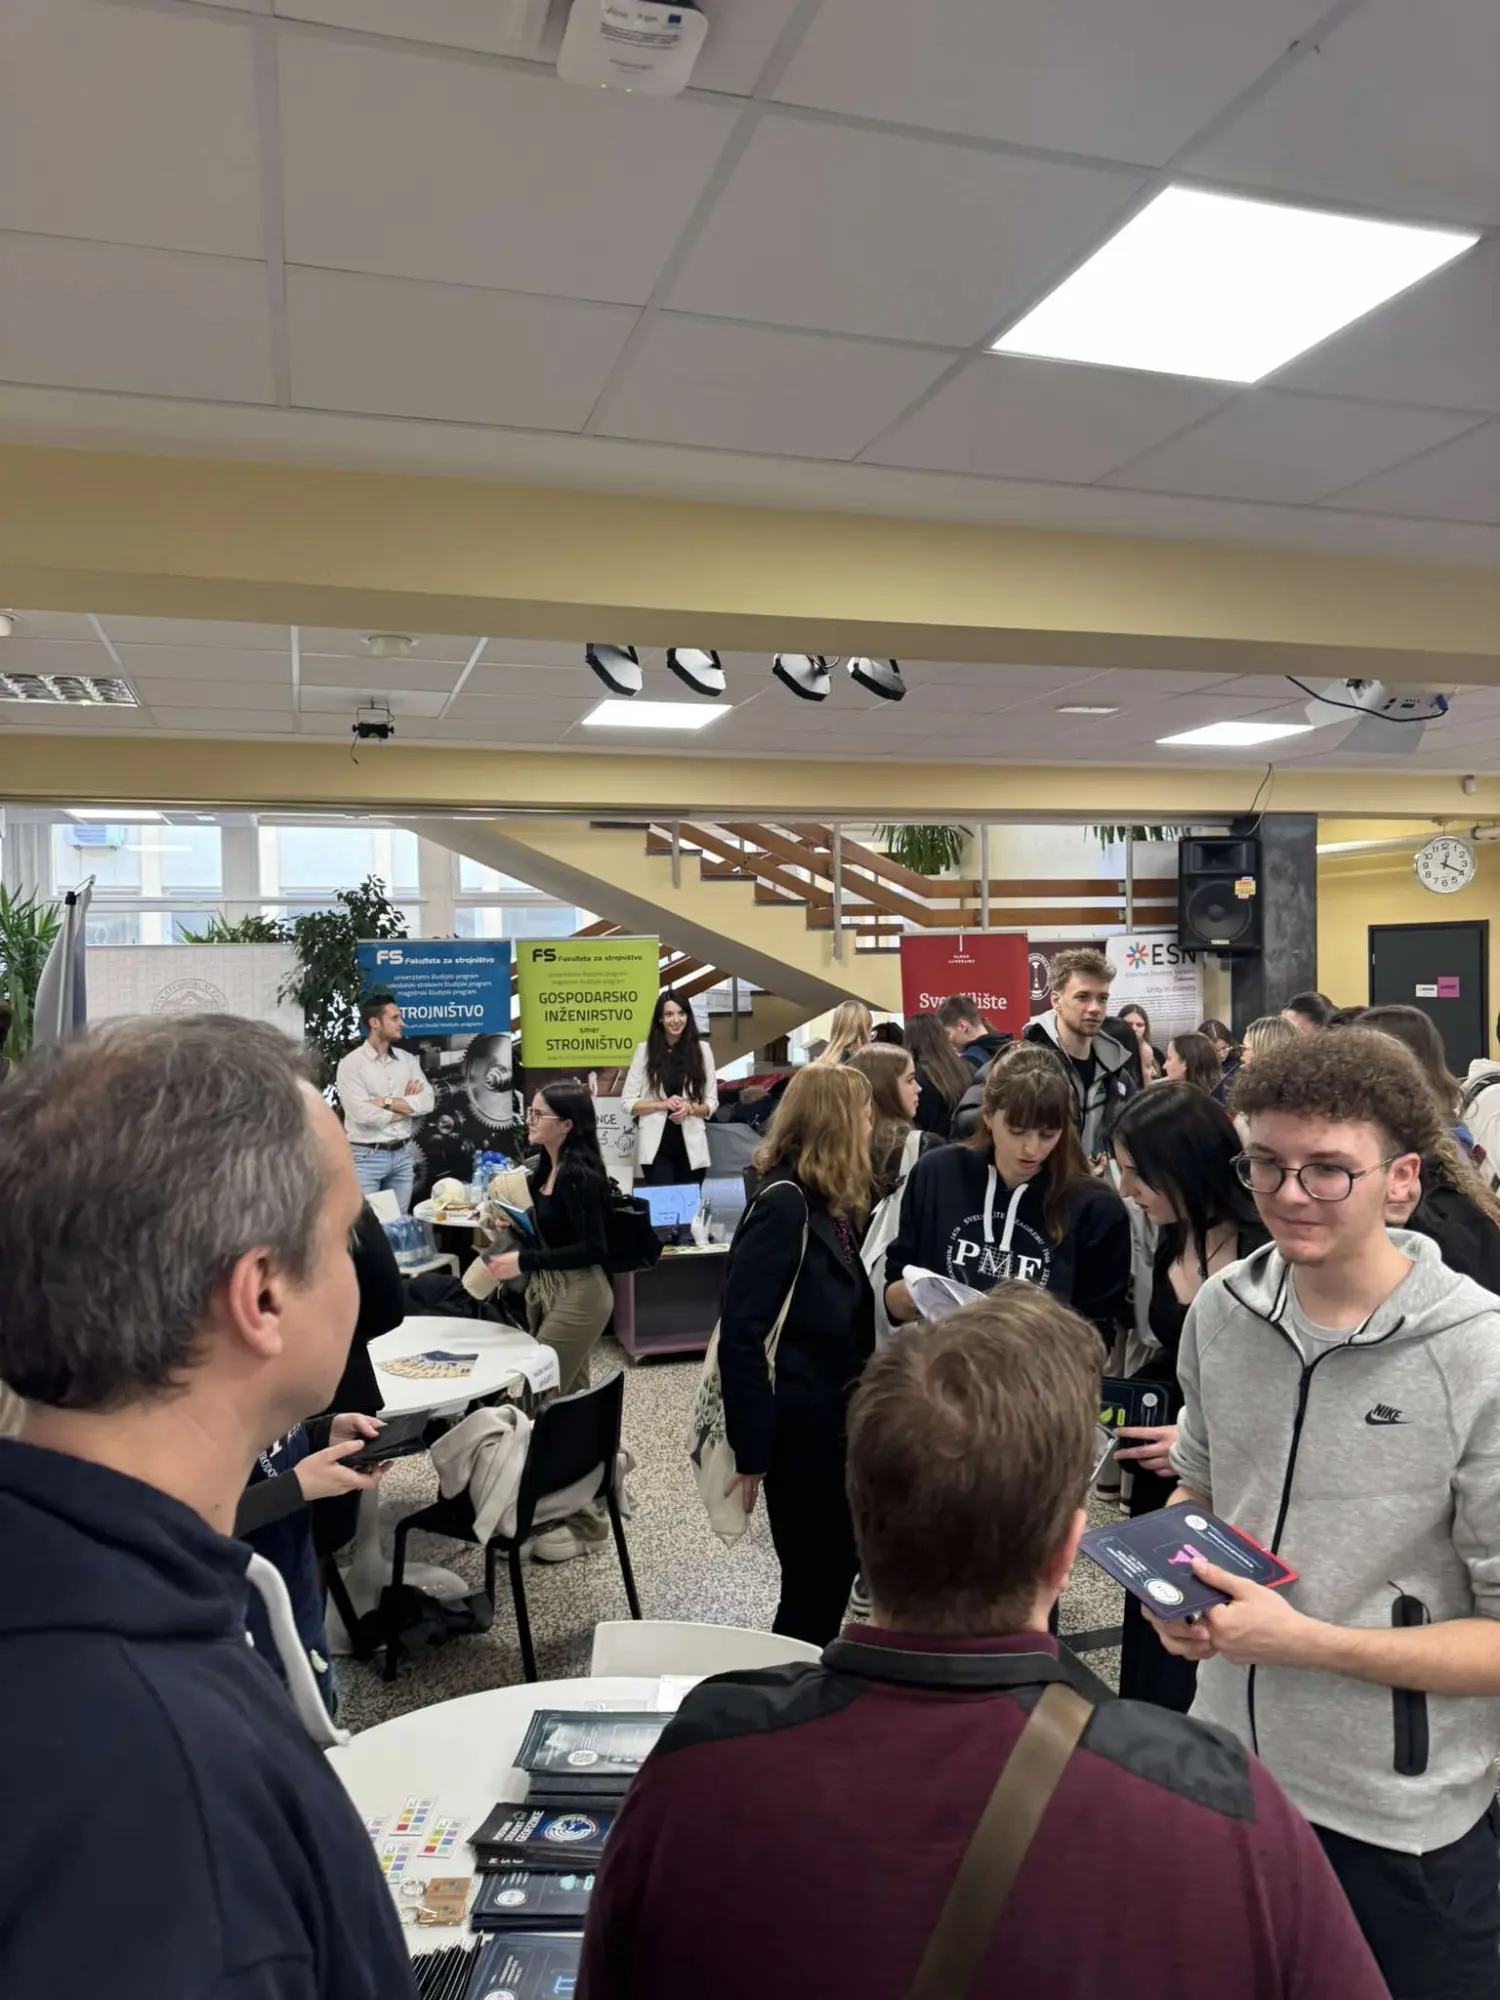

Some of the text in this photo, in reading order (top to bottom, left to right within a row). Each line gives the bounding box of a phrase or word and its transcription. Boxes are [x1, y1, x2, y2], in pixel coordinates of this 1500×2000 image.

[376, 949, 404, 965] FS
[532, 948, 557, 962] FS
[1152, 944, 1196, 965] ESN
[539, 991, 638, 1005] GOSPODARSKO
[919, 992, 1008, 1010] Svelište
[400, 1001, 484, 1019] TROJNIŠTVO
[544, 1006, 633, 1022] INŽENIRSTVO
[579, 1026, 600, 1034] smer
[546, 1035, 633, 1051] STROJNIŠTVO
[596, 1114, 617, 1125] NGE
[952, 1238, 1042, 1282] PMF
[1373, 1403, 1402, 1421] NIKE
